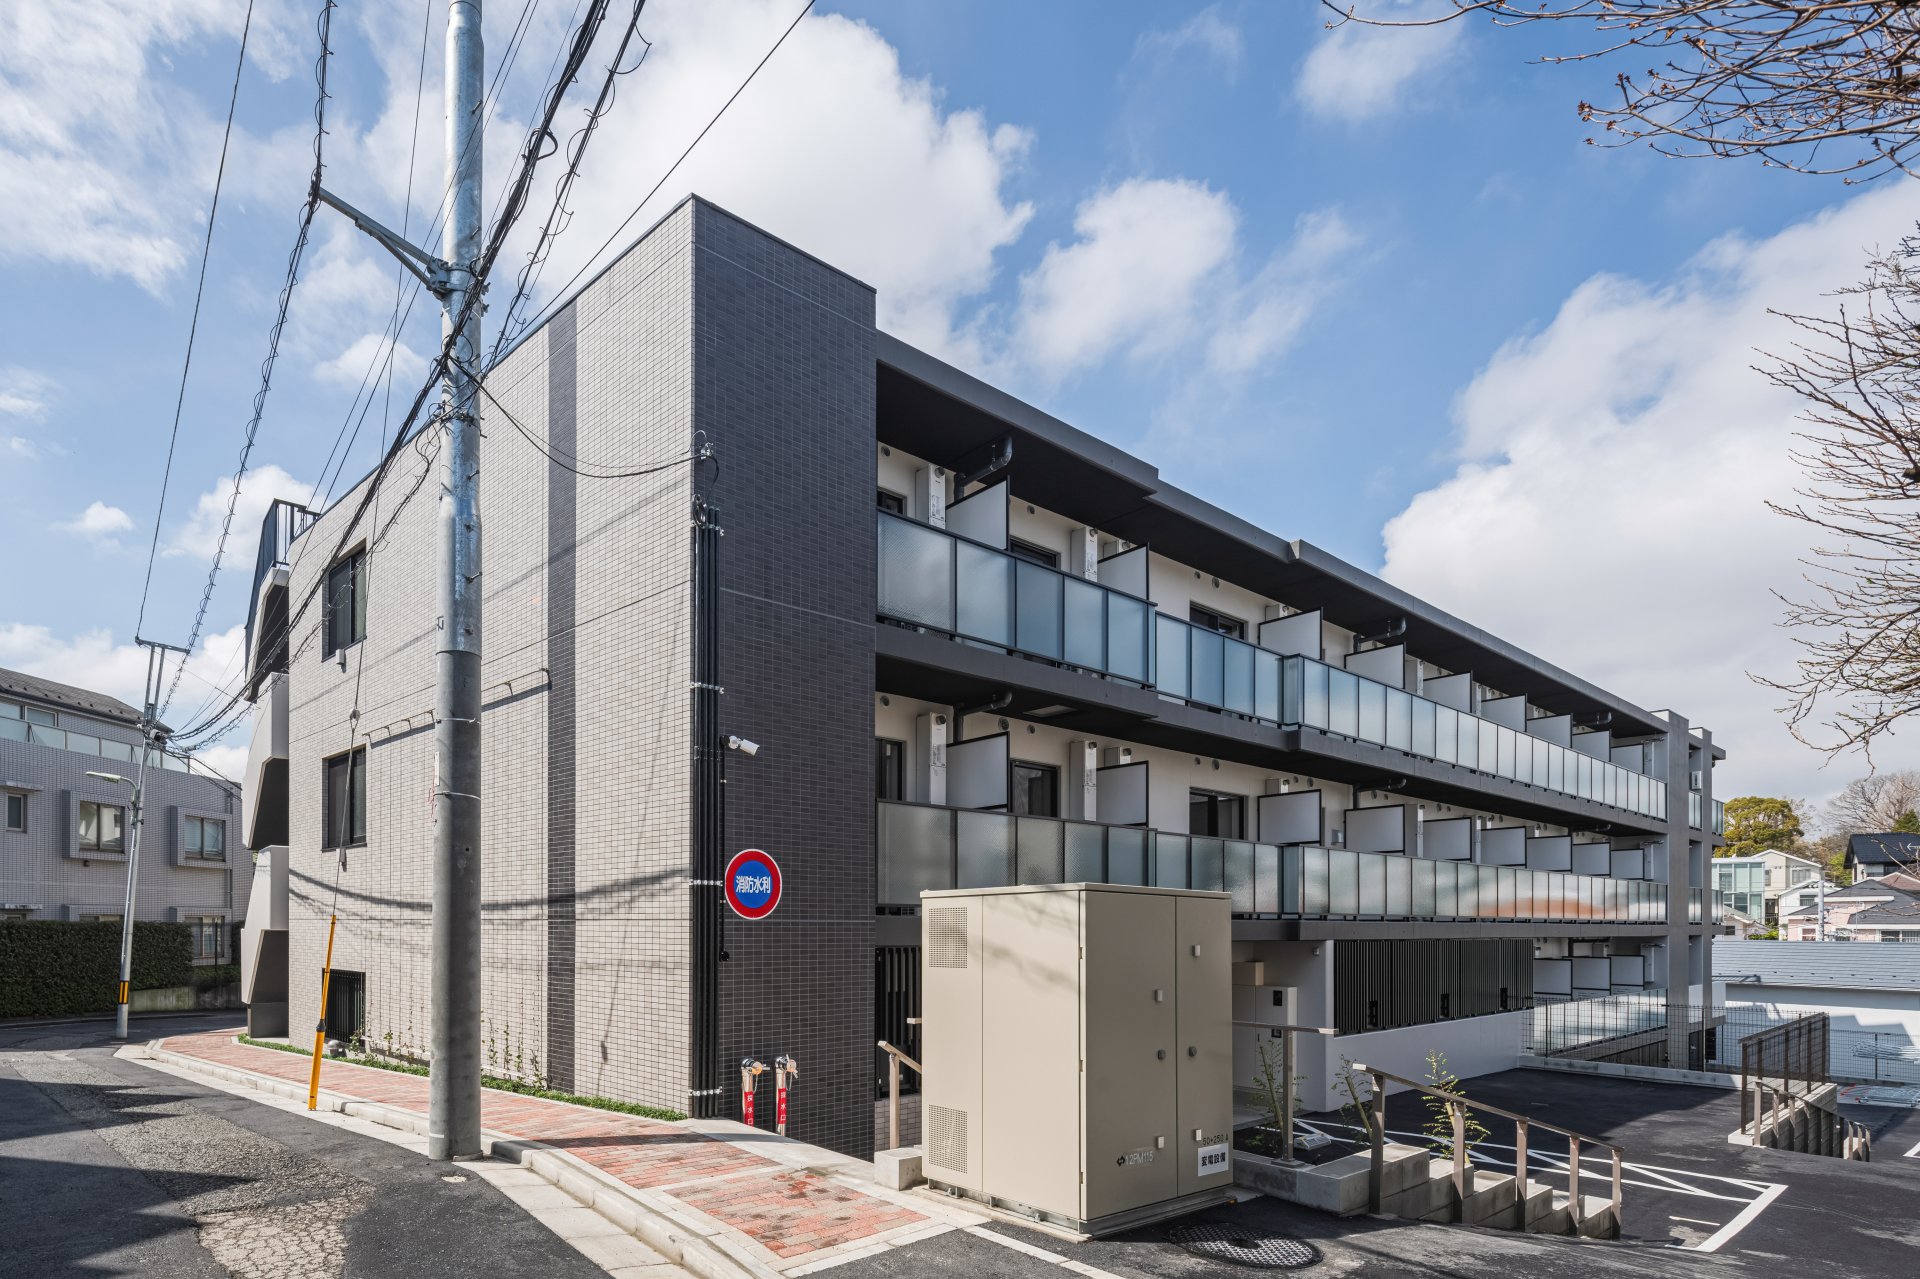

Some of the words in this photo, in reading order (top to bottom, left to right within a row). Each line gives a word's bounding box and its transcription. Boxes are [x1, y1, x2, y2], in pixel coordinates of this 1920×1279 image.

[736, 875, 771, 894] 消防水利
[1201, 1152, 1226, 1167] 変電設備
